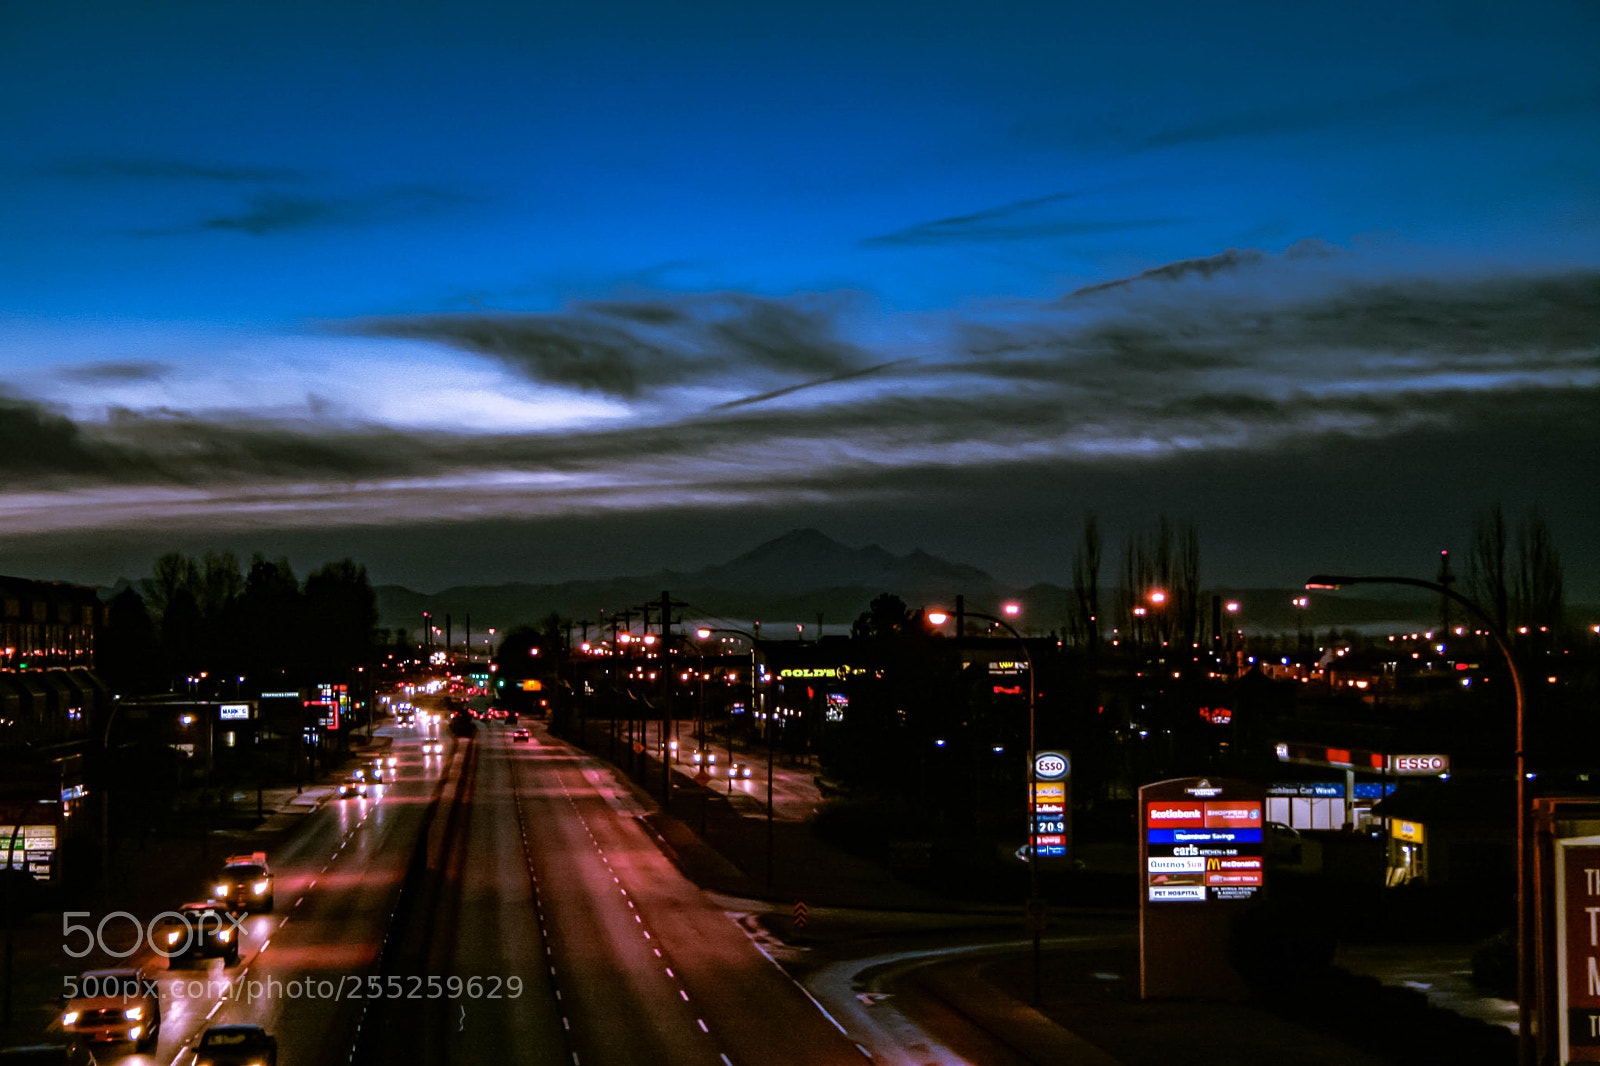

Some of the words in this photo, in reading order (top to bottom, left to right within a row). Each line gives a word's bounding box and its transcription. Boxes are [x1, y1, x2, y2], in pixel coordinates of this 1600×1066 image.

[780, 668, 836, 678] GOLD'S
[1396, 757, 1443, 770] ESSO
[1151, 809, 1201, 819] Scotiabank
[1173, 844, 1199, 856] earls
